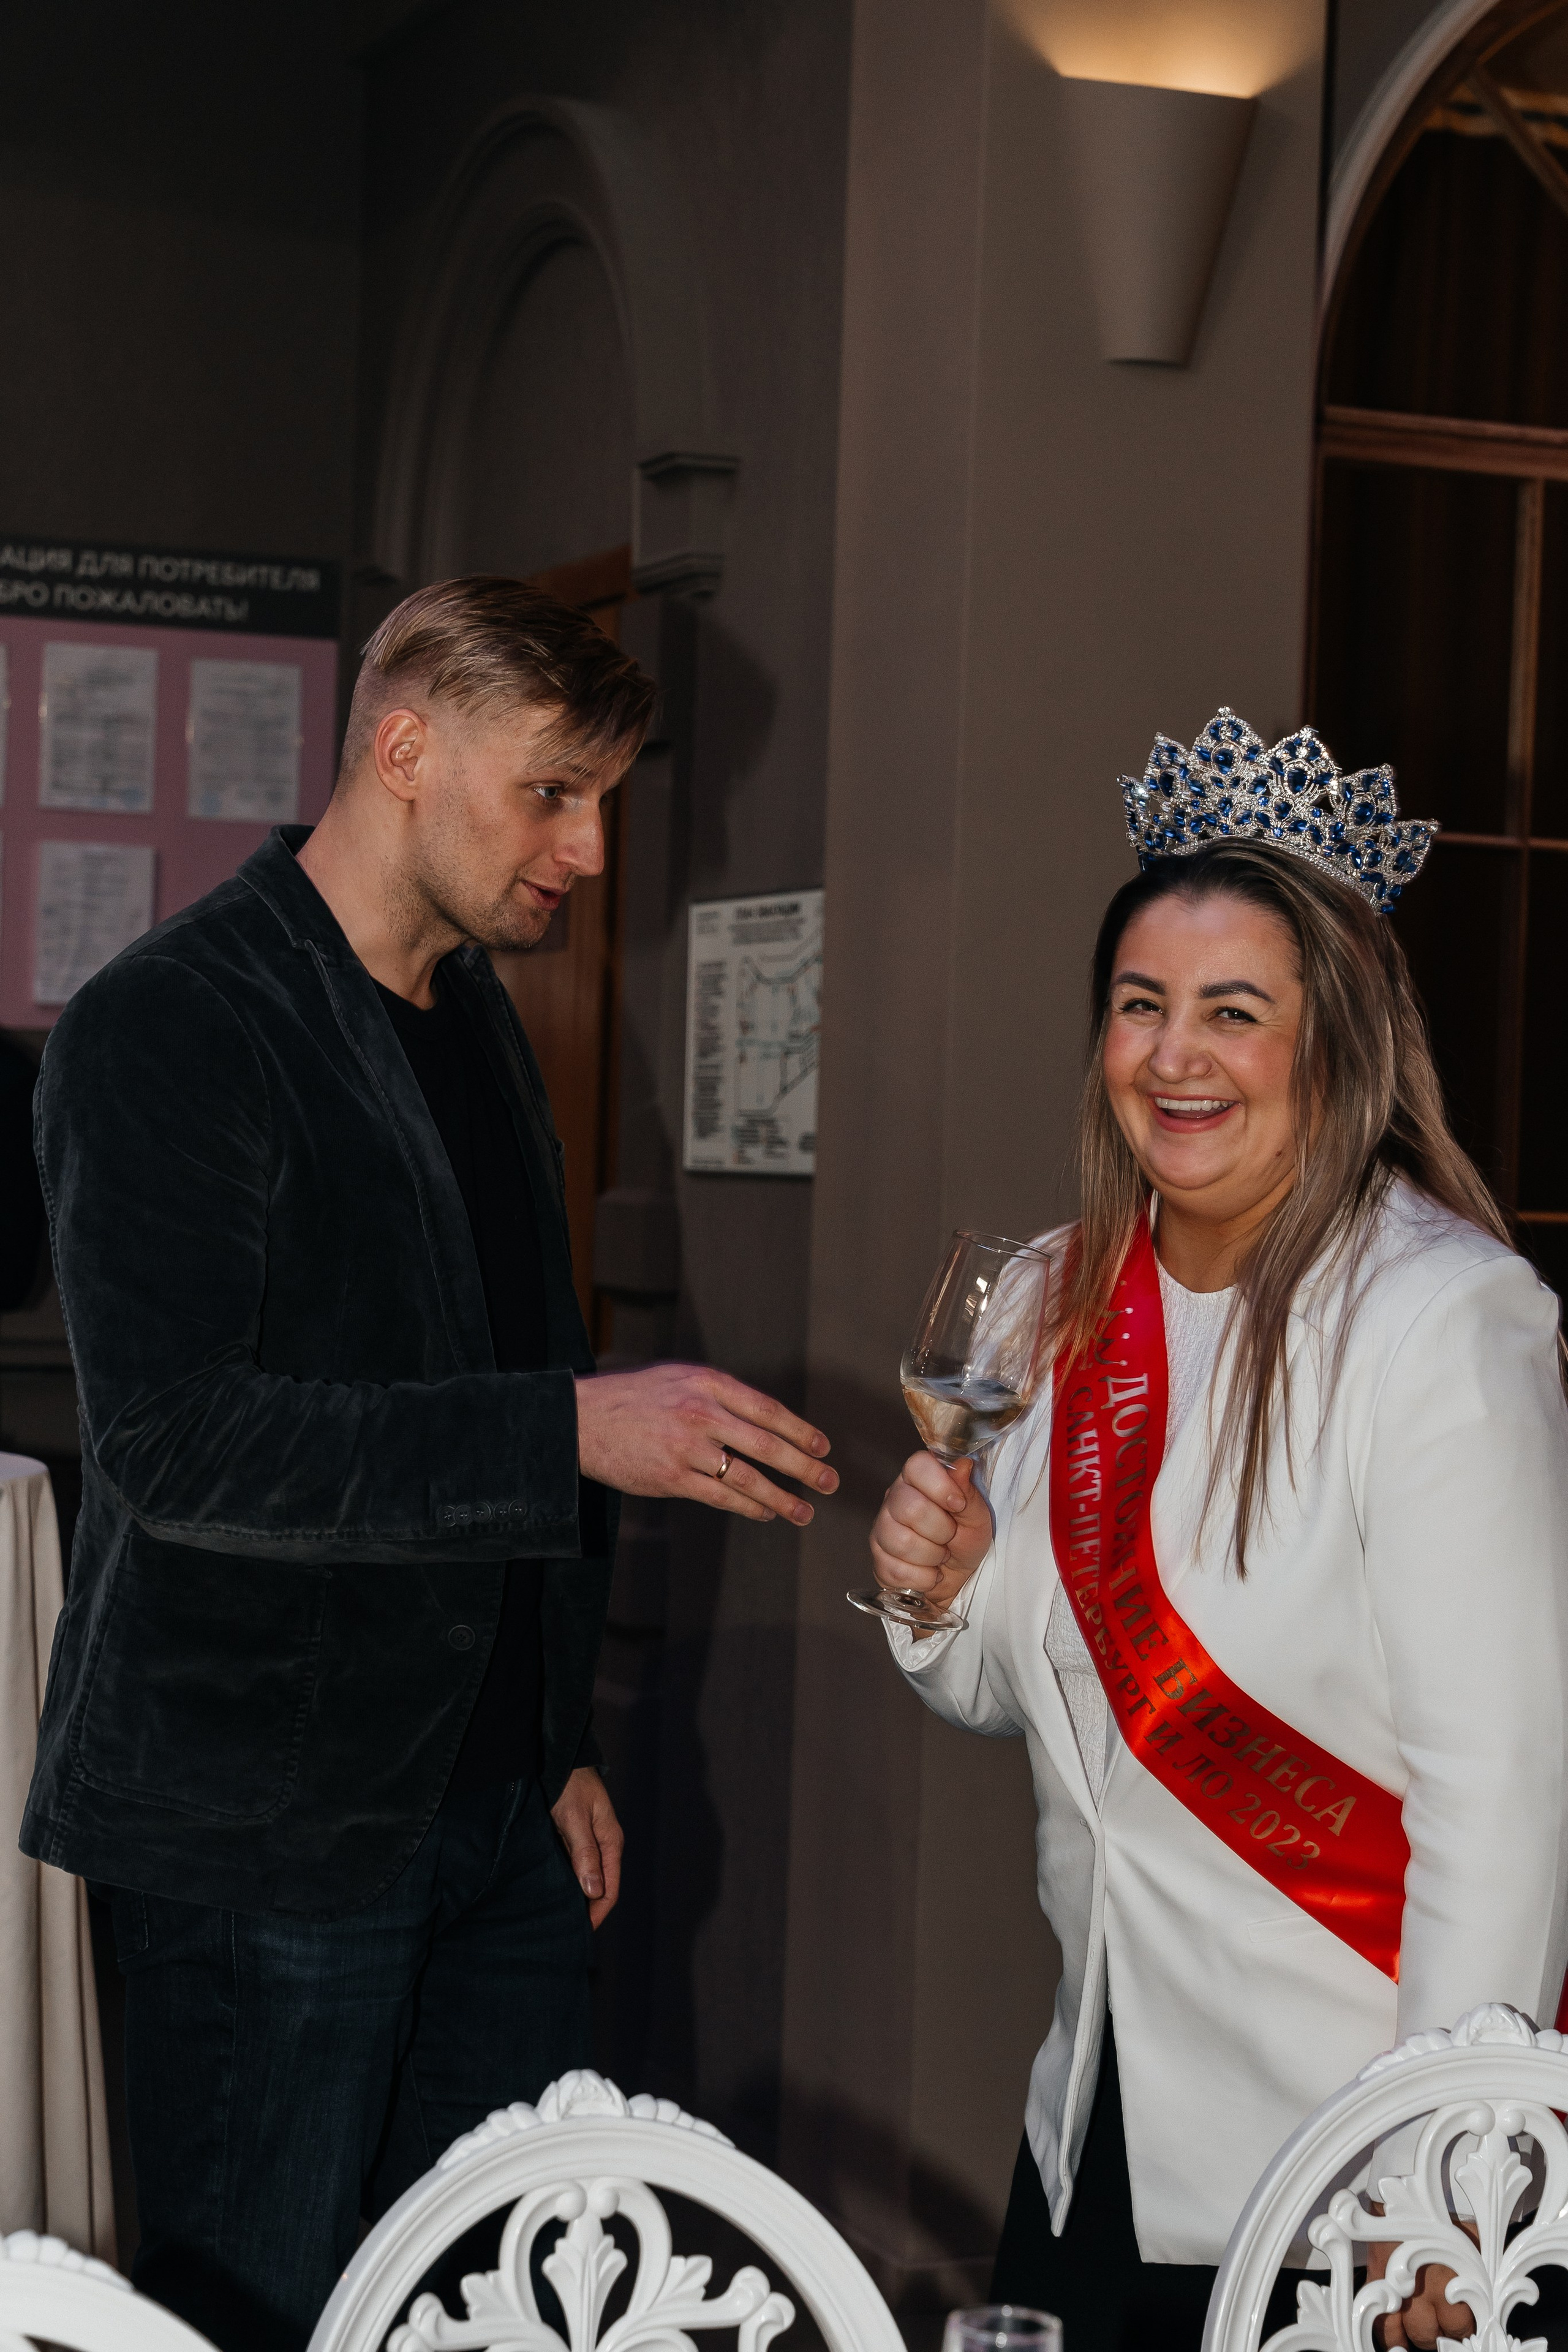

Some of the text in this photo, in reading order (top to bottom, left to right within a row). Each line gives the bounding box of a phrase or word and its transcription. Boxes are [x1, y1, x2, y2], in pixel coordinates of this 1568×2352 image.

[75, 550, 135, 578] ДЛЯ
[137, 554, 320, 592] ПОТРЕБИТЕЛЯ
[1068, 1387, 1321, 1870] САНКТ-ПЕТЕРБУРГ И ЛО 2023
[1153, 1657, 1357, 1837] БИЗНЕСА
